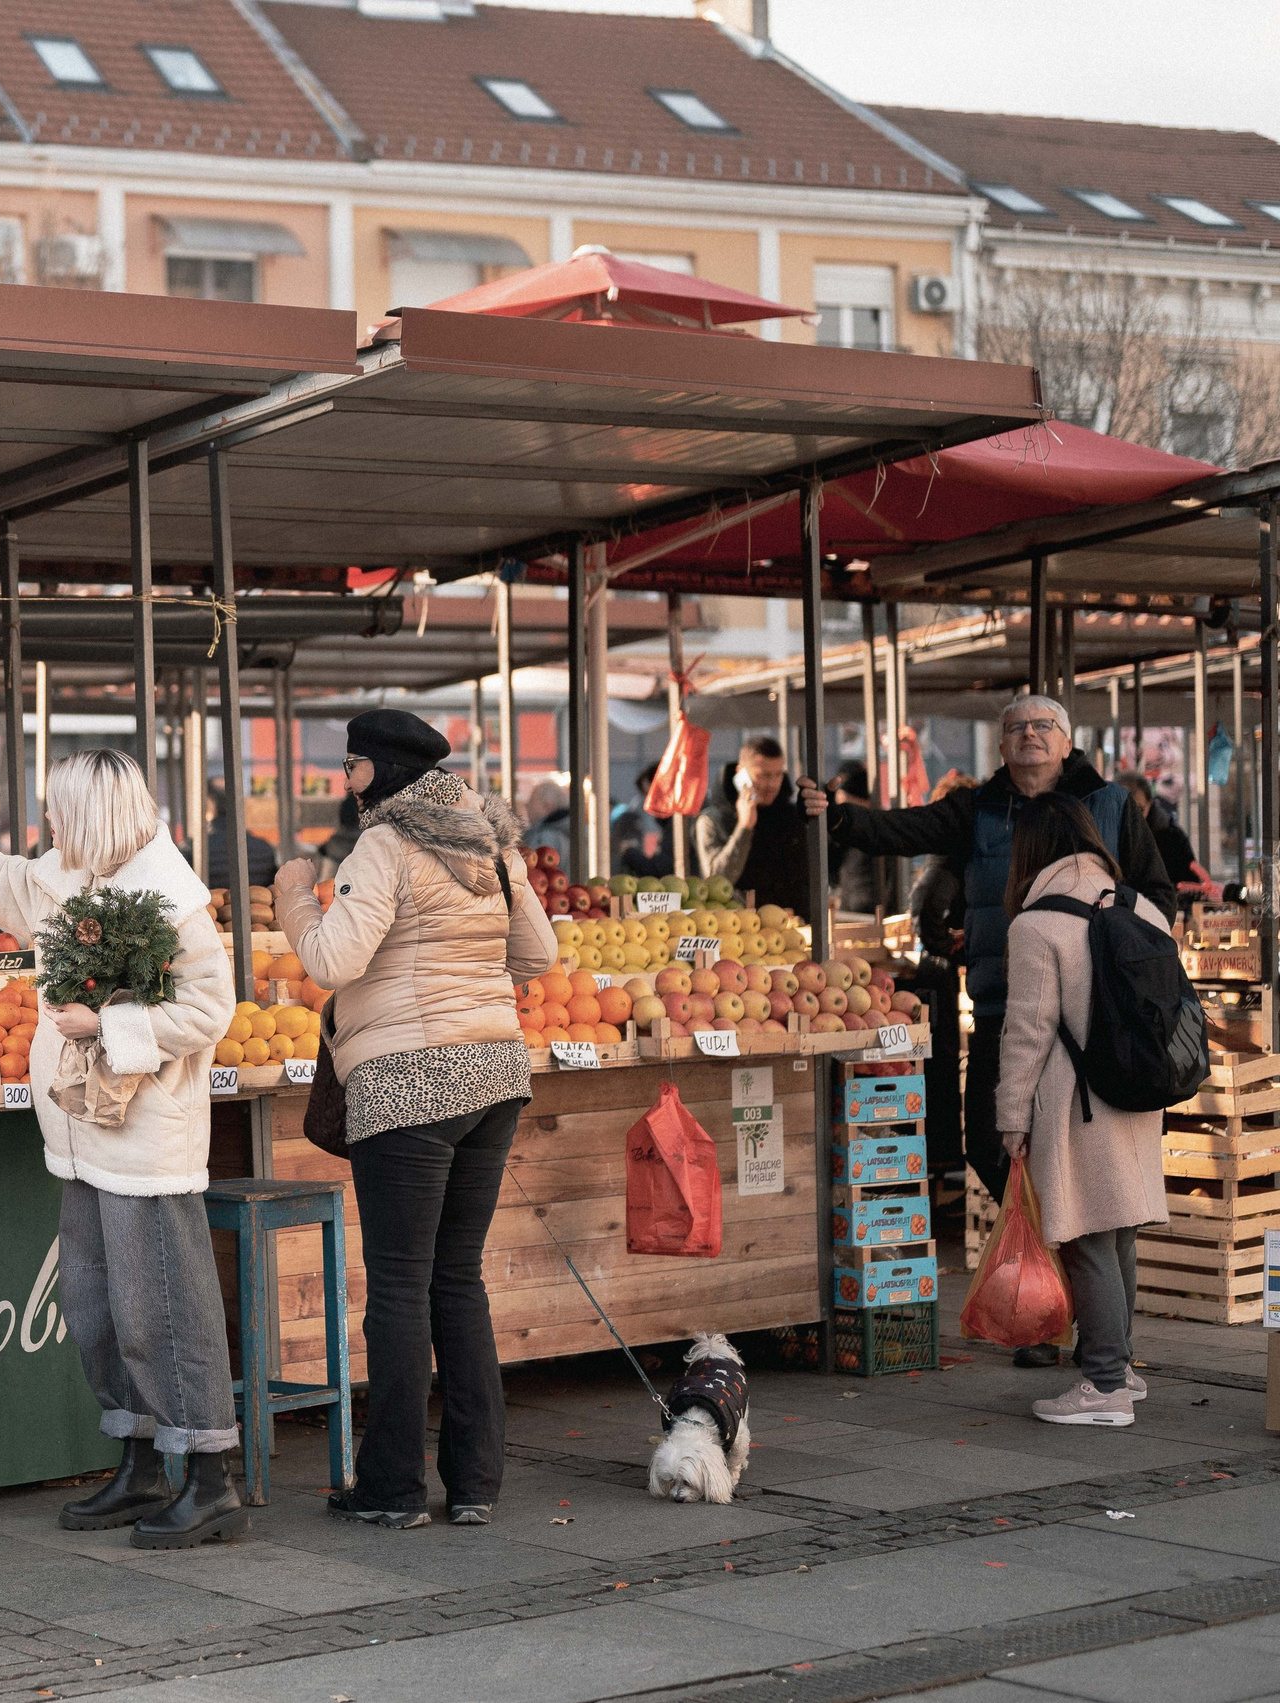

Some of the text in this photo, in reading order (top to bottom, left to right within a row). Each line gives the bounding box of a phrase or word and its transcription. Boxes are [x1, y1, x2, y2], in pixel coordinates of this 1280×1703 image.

[880, 1025, 908, 1049] 200
[553, 1042, 593, 1051] SLATKA
[211, 1070, 238, 1089] 250
[5, 1087, 29, 1103] 300
[743, 1107, 762, 1120] 003
[744, 1158, 782, 1174] Градске
[744, 1171, 777, 1185] пијаце
